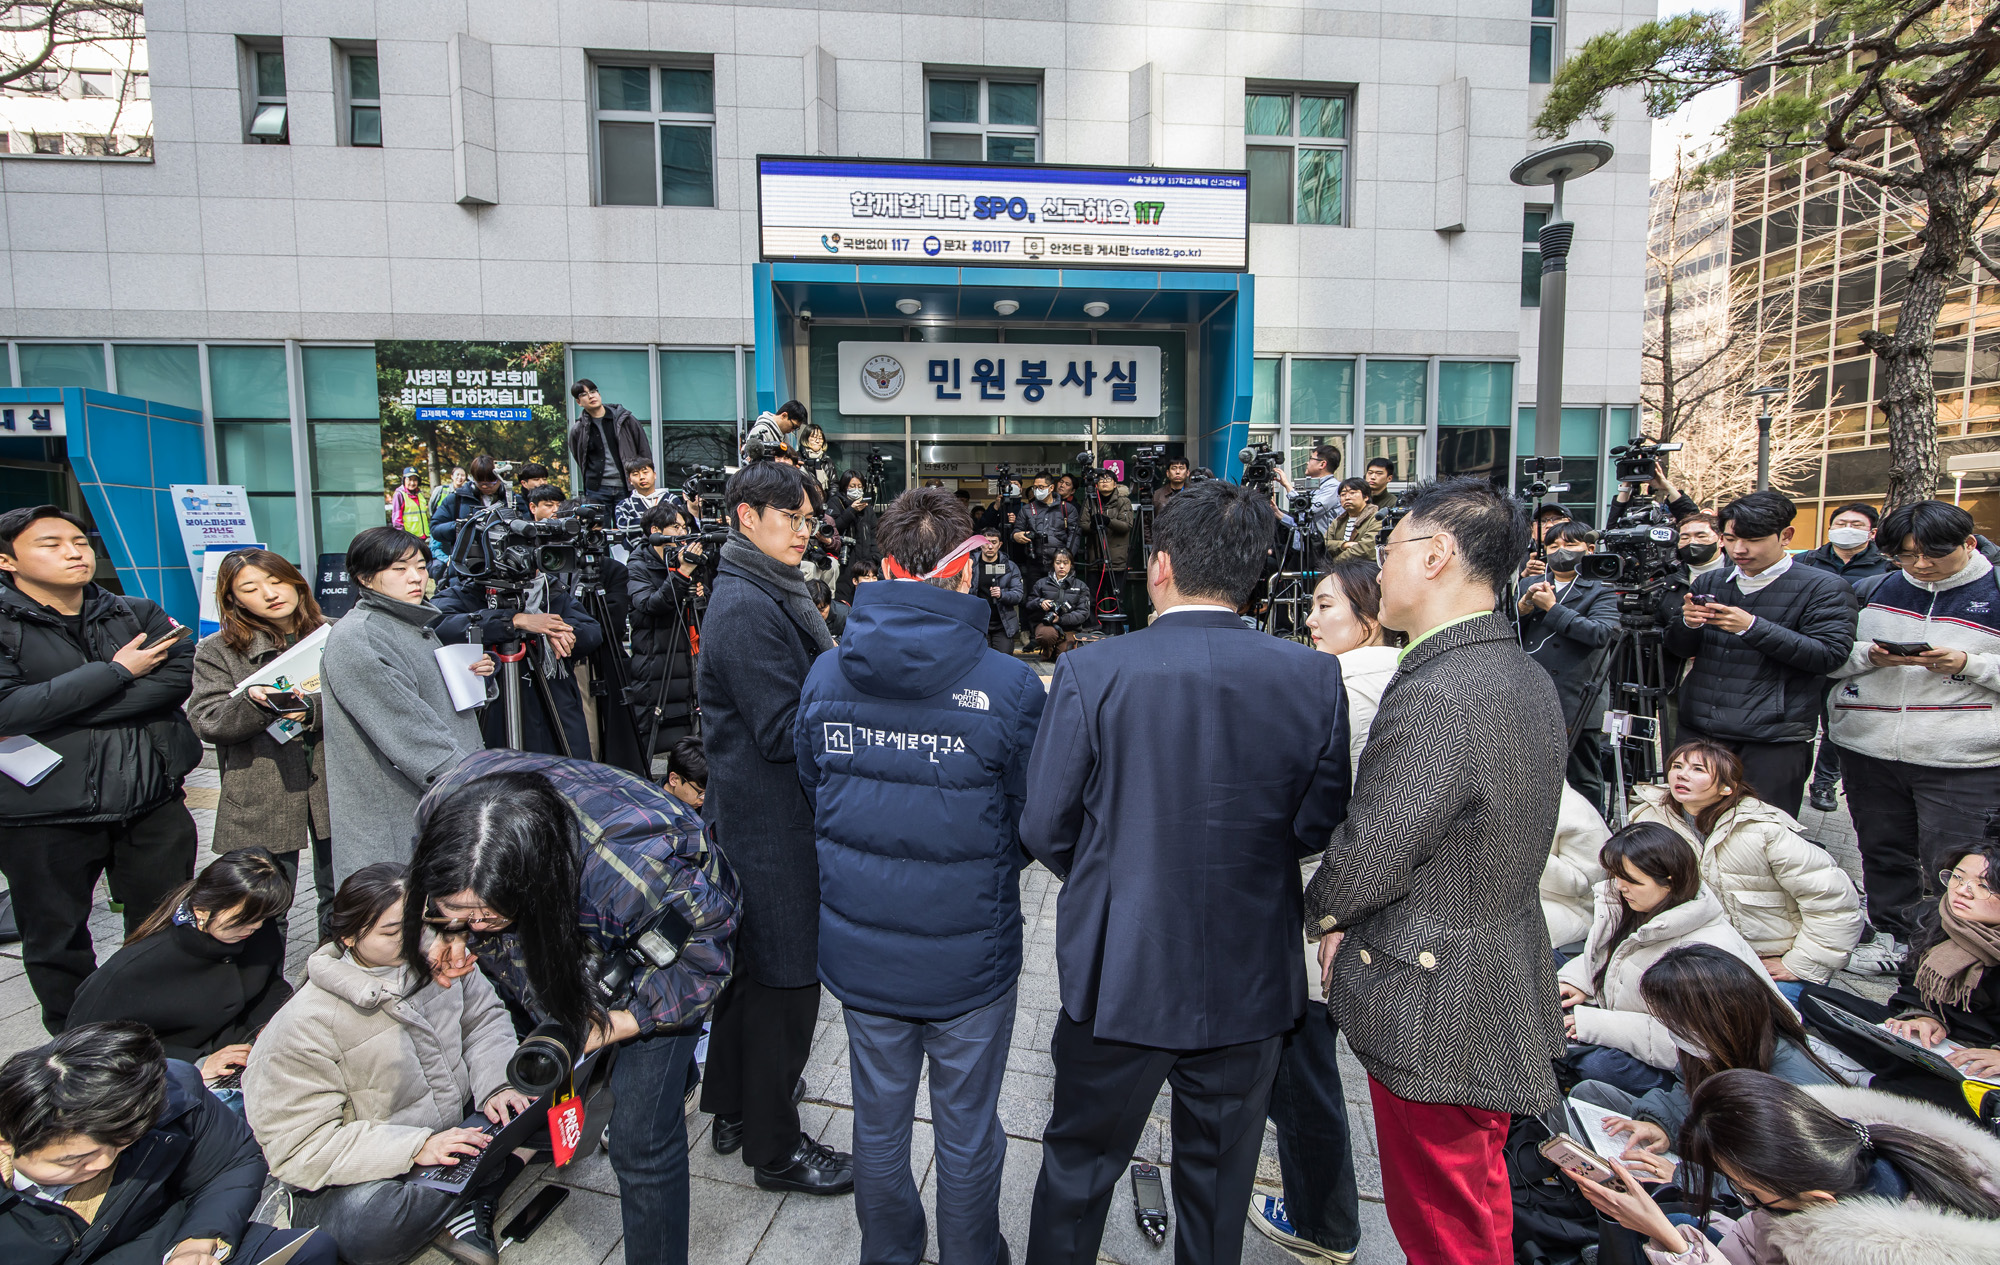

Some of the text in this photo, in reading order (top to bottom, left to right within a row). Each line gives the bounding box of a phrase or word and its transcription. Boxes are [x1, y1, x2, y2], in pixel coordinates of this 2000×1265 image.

[1210, 178, 1240, 187] 신고센터
[850, 191, 1166, 225] 함께합니다 SPO, 신고해요 117
[843, 238, 910, 251] 국번없이 117
[944, 239, 1011, 253] 문자 #0117
[1050, 243, 1094, 256] 안전드림
[405, 369, 538, 387] 사회적 약자 보호에
[928, 358, 1138, 403] 민원봉사실
[400, 388, 545, 406] 최선을 다하겠습니다
[471, 410, 498, 418] 노인학대
[499, 410, 513, 418] 신고
[514, 410, 528, 418] 112
[185, 518, 247, 526] 보이스피싱제로
[321, 587, 348, 595] POLICE
[952, 692, 979, 703] NORTH
[963, 688, 979, 697] THE
[957, 700, 978, 709] FACE
[856, 726, 966, 763] 가로세로연구소
[562, 1106, 581, 1149] PRESS
